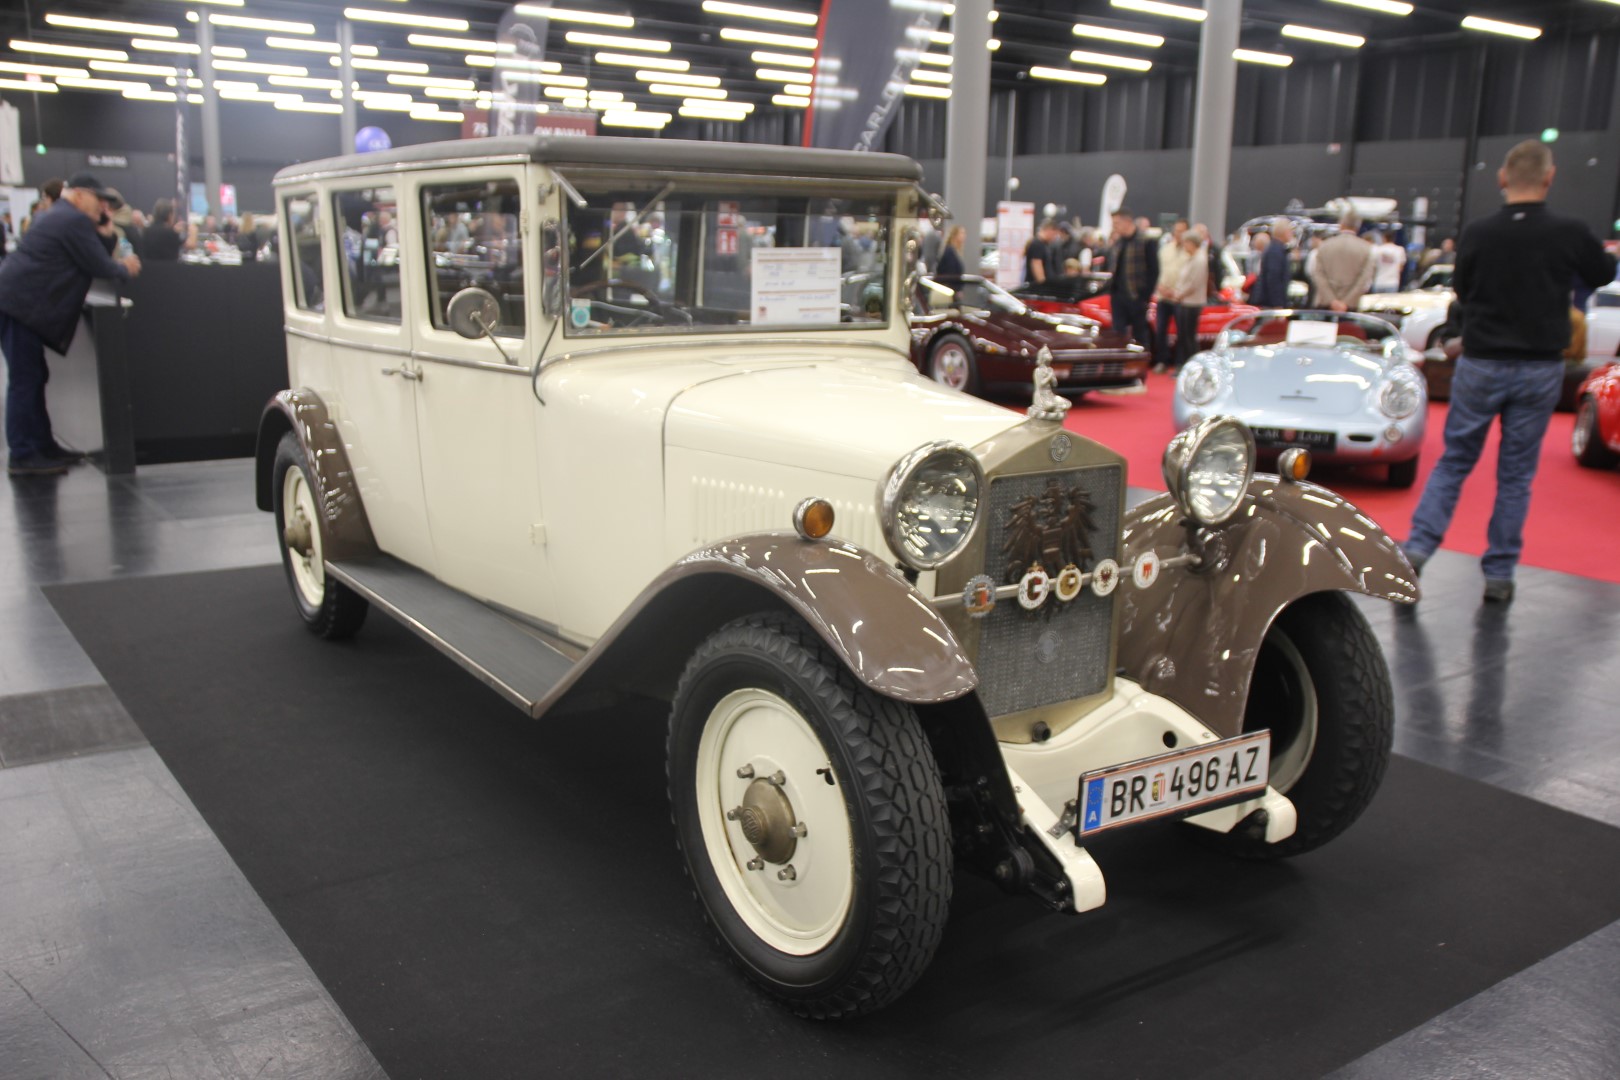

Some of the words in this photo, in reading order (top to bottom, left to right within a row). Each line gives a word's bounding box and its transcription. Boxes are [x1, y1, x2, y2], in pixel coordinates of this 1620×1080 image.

[1110, 775, 1147, 818] BR
[1170, 757, 1221, 801] 496
[1226, 746, 1260, 787] AZ
[1088, 810, 1098, 824] A
